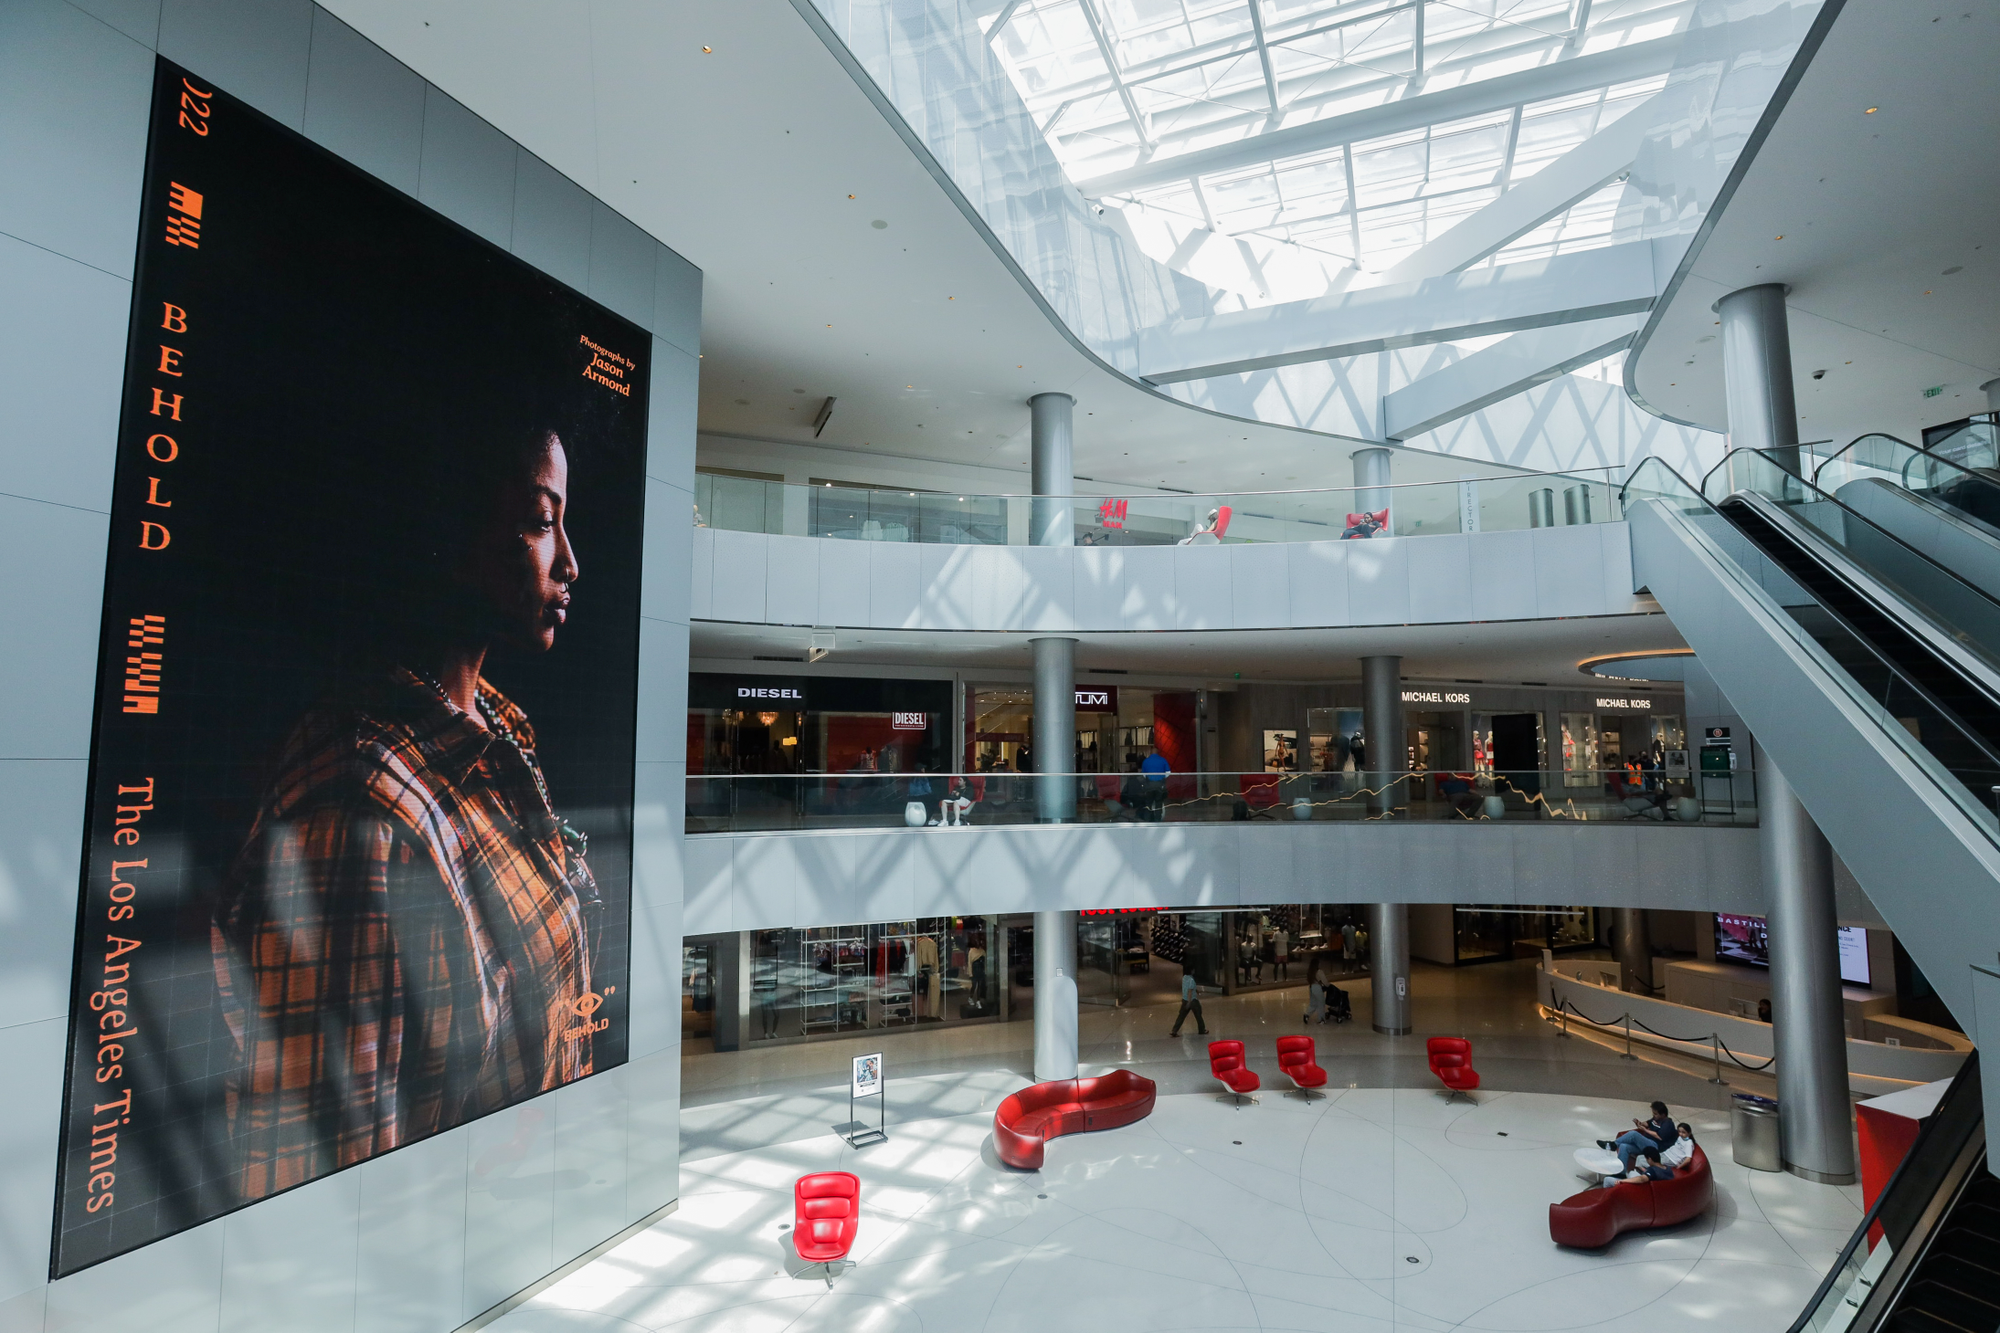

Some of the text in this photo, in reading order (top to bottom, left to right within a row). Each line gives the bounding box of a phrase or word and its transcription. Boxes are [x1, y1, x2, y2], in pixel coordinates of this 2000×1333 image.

[580, 334, 636, 371] Photographs by
[590, 352, 624, 379] Jason
[582, 365, 631, 397] Armond
[139, 302, 188, 551] BEHOLD
[1099, 498, 1128, 521] H&M
[1102, 520, 1123, 529] MAN
[737, 687, 802, 699] DIESEL
[1401, 691, 1470, 704] MICHAEL KORS
[1596, 698, 1651, 709] MICHAEL KORS
[894, 712, 924, 725] DIESEL
[1717, 916, 1767, 929] BASTILL
[86, 777, 154, 1213] The Los Angeles Times
[564, 1018, 609, 1043] BEHOLD
